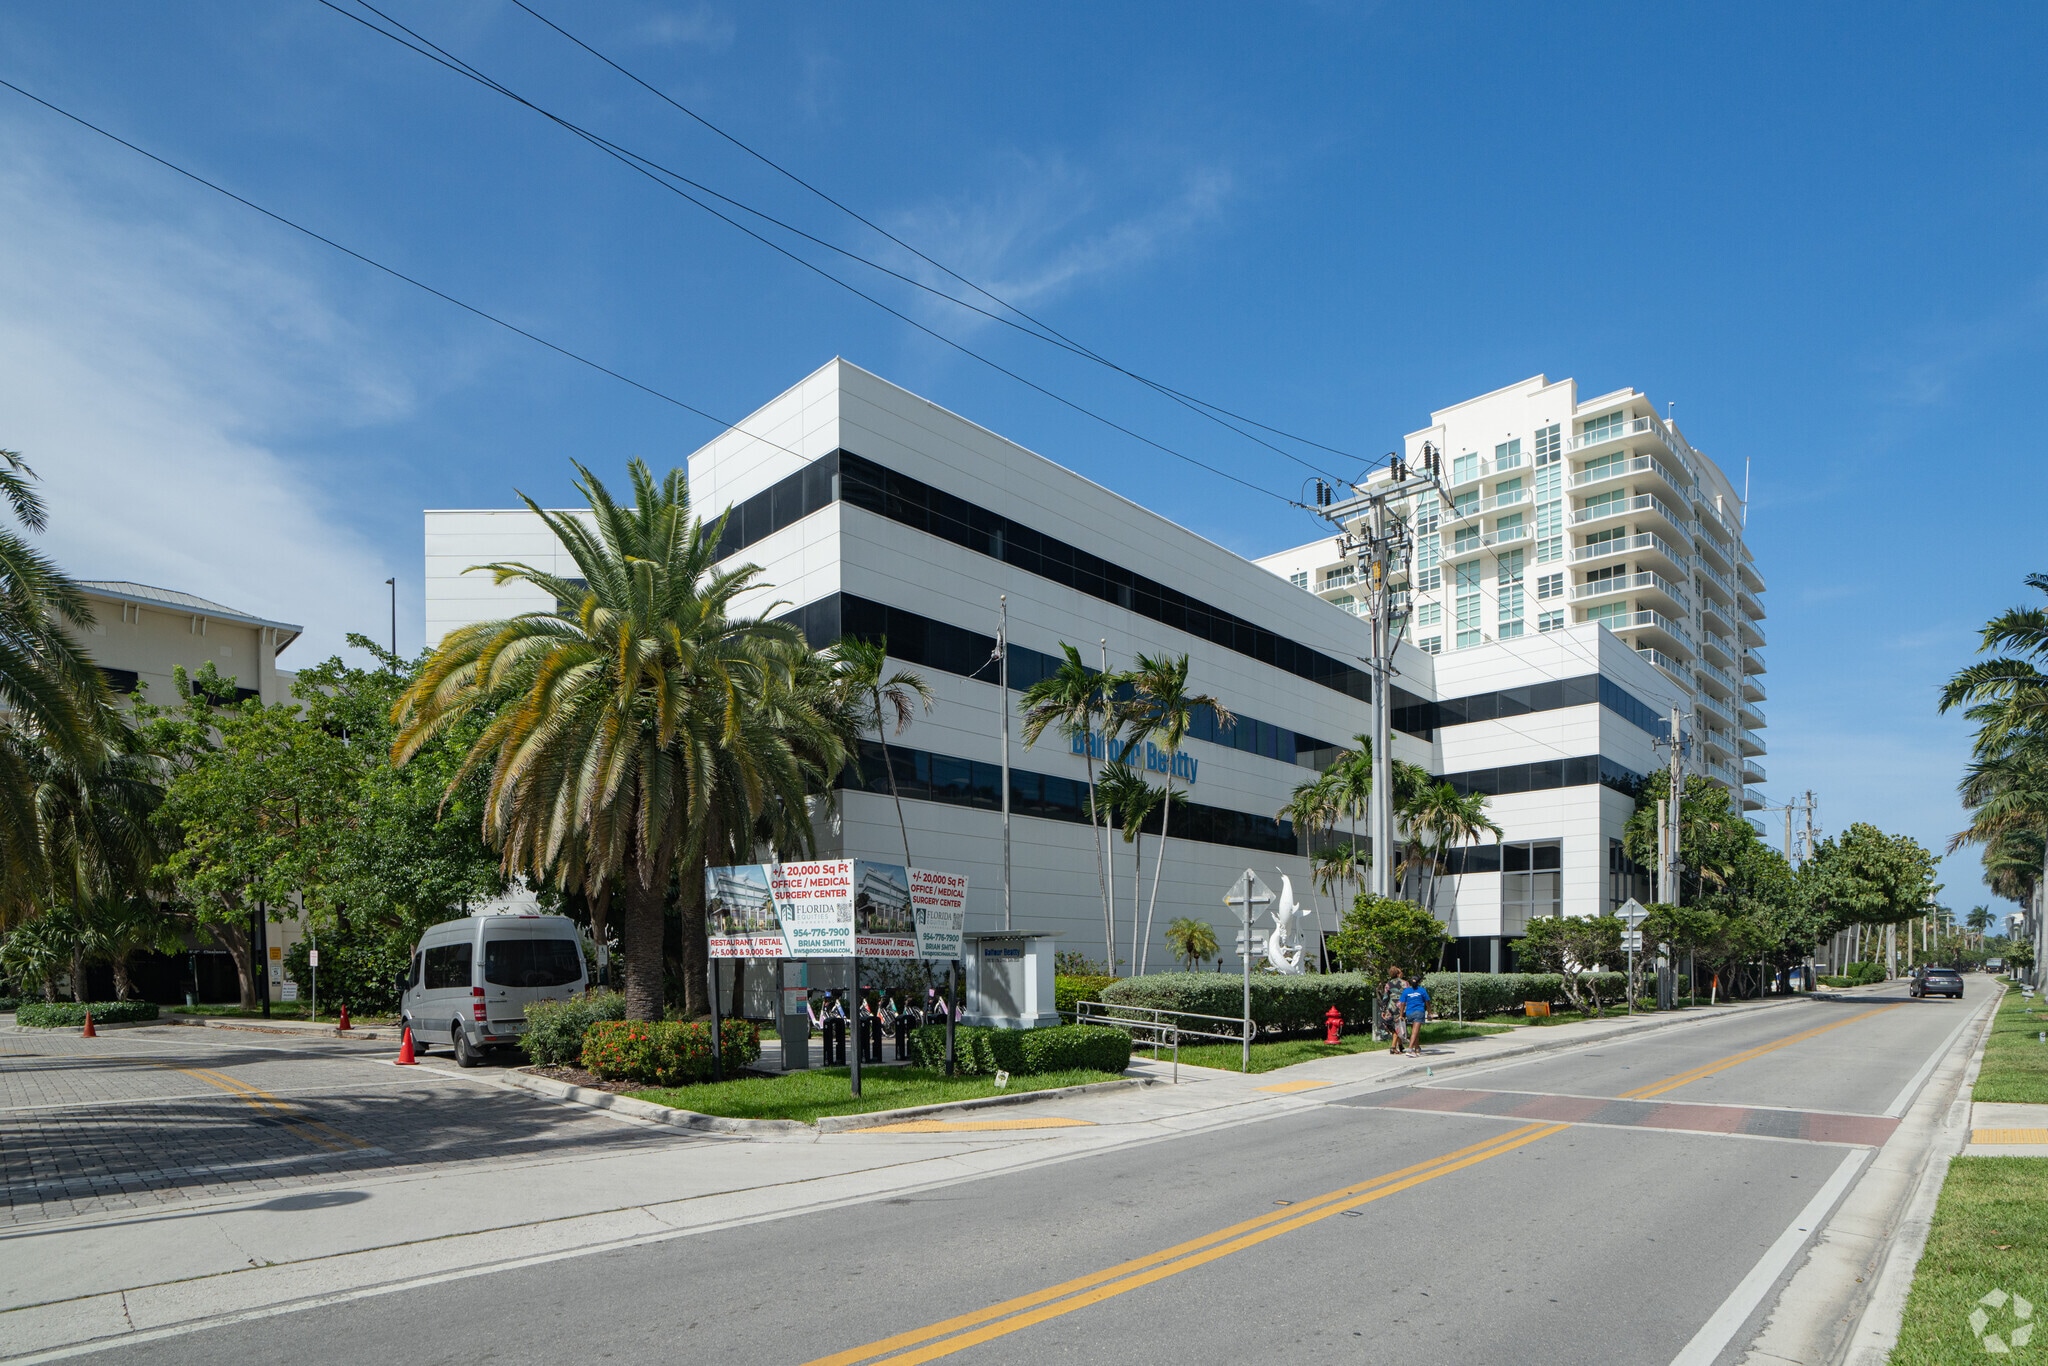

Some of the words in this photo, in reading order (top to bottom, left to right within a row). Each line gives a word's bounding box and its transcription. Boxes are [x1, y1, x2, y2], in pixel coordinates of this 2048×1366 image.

[773, 866, 785, 878] +/-
[787, 865, 820, 877] 20,000
[823, 864, 835, 875] Sq
[838, 863, 848, 873] Ft
[771, 879, 802, 889] OFFICE
[810, 877, 850, 887] MEDICAL
[923, 873, 946, 885] 20,000
[948, 876, 956, 888] Sq
[957, 878, 965, 887] Ft
[774, 890, 812, 900] SURGERY
[814, 889, 847, 898] CENTER
[911, 884, 933, 894] OFFICE
[938, 887, 964, 898] MEDICAL
[913, 895, 938, 906] SURGERY
[940, 898, 961, 908] CENTER
[796, 904, 834, 913] FLORIDA
[927, 911, 952, 921] FLORIDA
[793, 928, 850, 937] 954-776-7900
[922, 932, 960, 942] 954-776-7900
[759, 938, 782, 946] RETAIL
[822, 939, 845, 947] SMITH
[856, 937, 893, 946] RESTAURANT
[897, 939, 915, 947] RETAIL
[925, 942, 940, 950] BRIAN
[746, 948, 764, 956] 9,000
[765, 948, 774, 956] Sq
[865, 947, 880, 956] 5,000
[886, 949, 900, 957] 9,000
